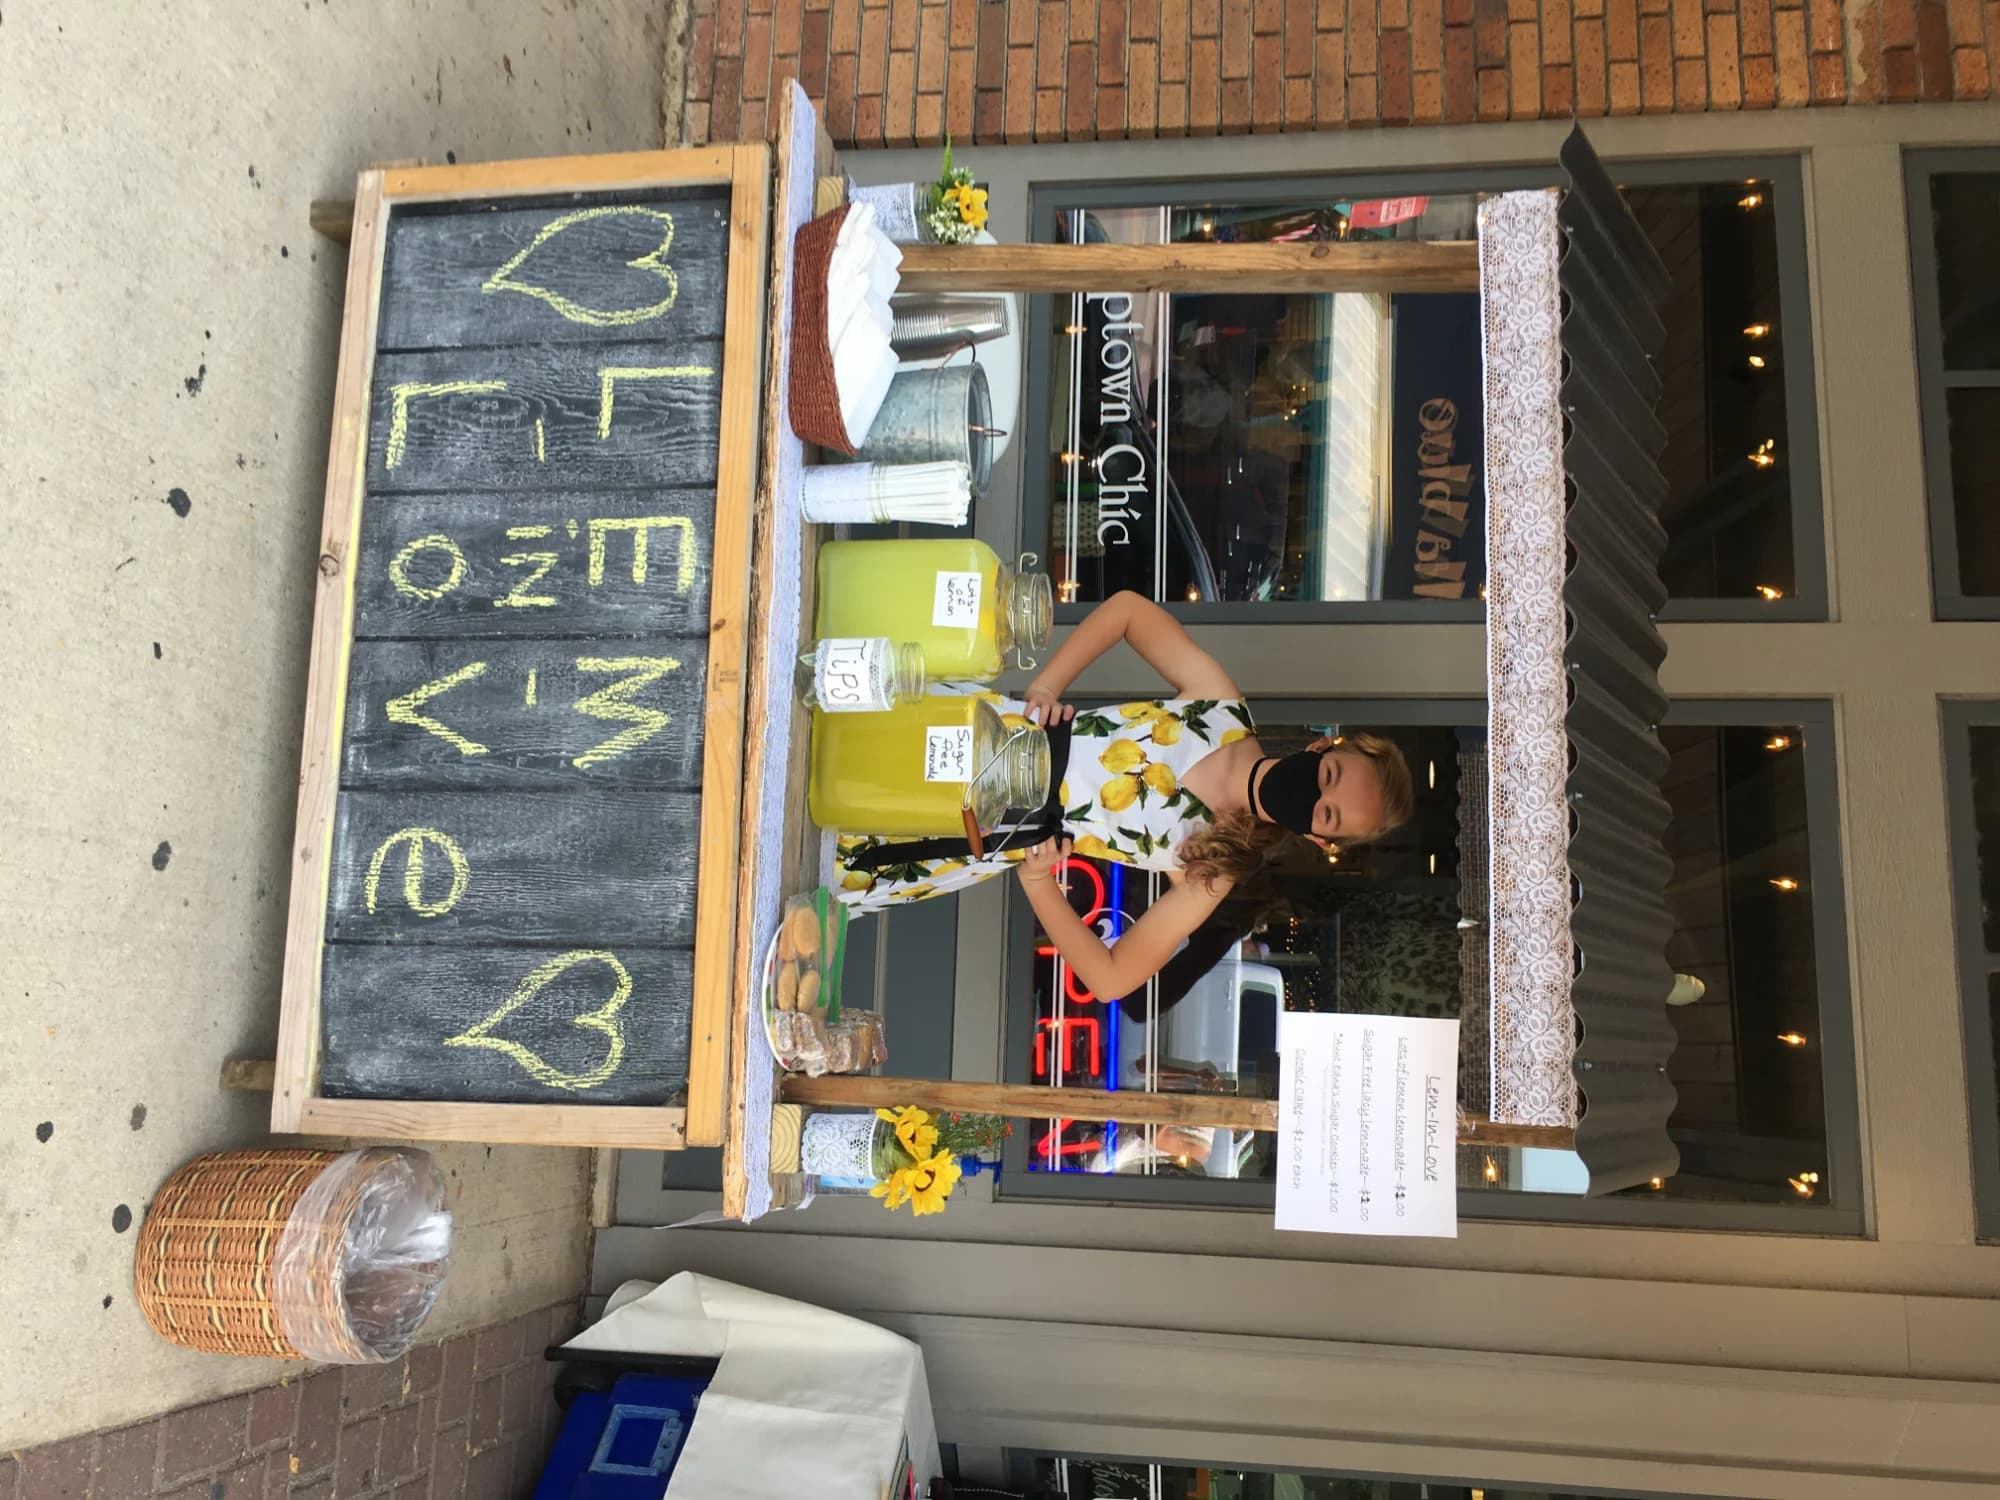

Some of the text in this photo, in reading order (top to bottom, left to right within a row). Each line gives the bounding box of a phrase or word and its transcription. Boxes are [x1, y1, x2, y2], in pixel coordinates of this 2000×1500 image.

[1086, 292, 1145, 426] ptown
[572, 365, 715, 769] LEM
[951, 728, 970, 777] Sugar
[1362, 1028, 1374, 1062] Sugar
[1397, 1036, 1409, 1060] Lots
[1362, 1065, 1373, 1088] Free
[1395, 1063, 1411, 1076] of
[1292, 1128, 1304, 1161] $1.00
[1424, 1074, 1441, 1182] Lem-In-Love
[1292, 1164, 1301, 1190] each
[1328, 1182, 1339, 1213] $1.00
